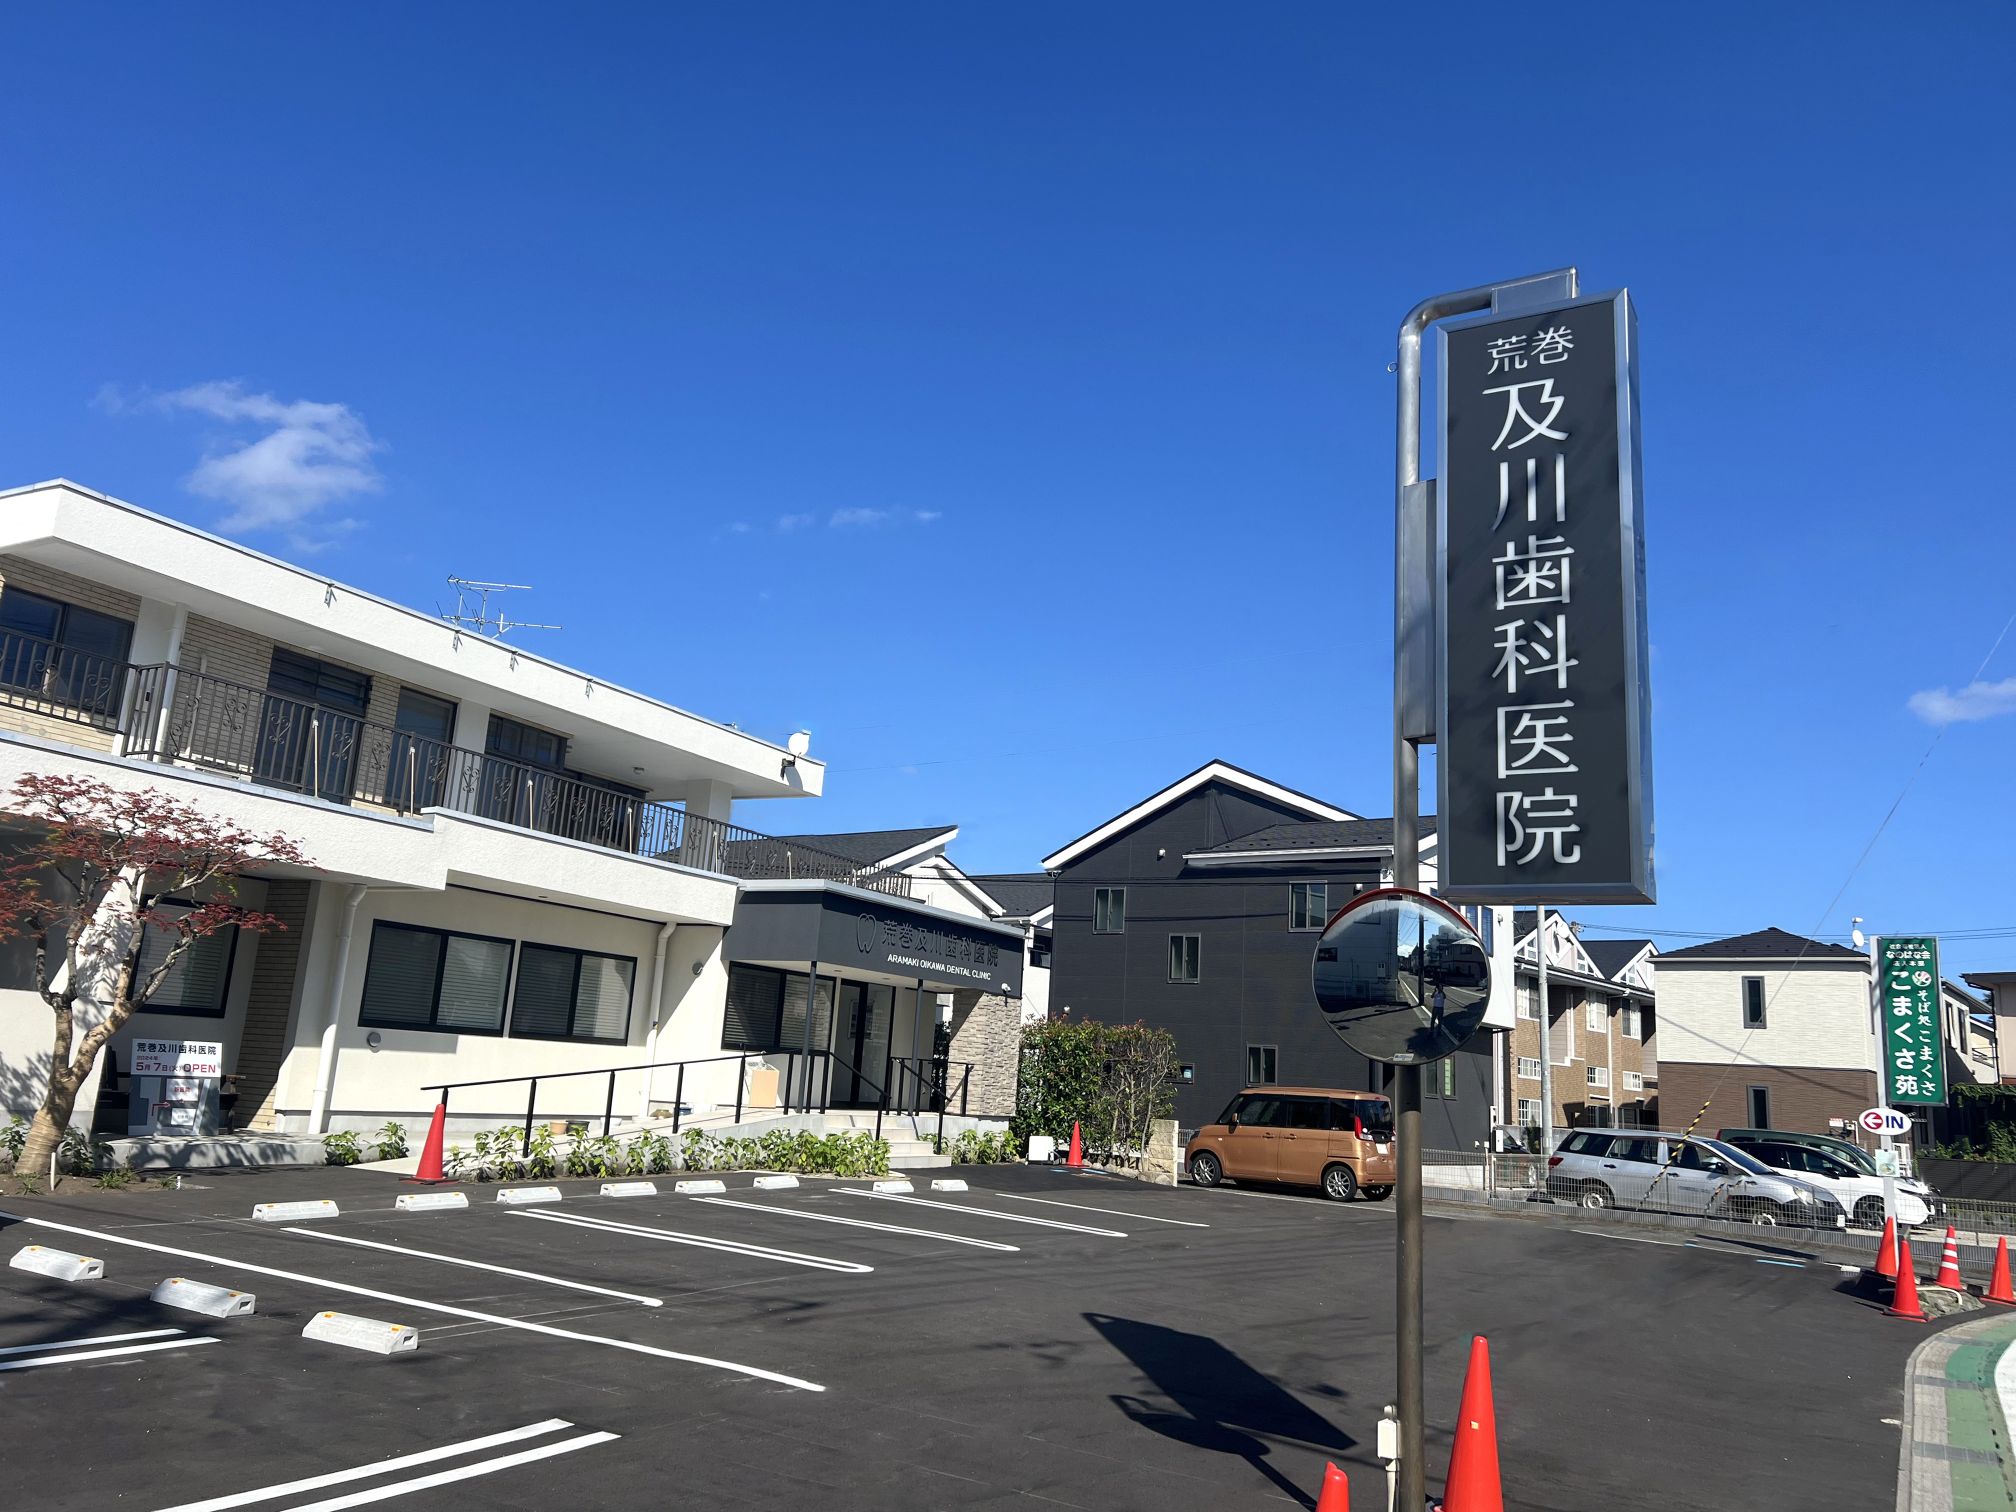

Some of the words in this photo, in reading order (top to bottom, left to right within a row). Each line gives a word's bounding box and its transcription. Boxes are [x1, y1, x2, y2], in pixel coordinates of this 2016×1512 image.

[1486, 326, 1574, 375] 荒巻
[1481, 376, 1581, 868] 及川歯科医院
[881, 919, 1000, 967] 荒巻及川歯科医院
[887, 953, 919, 967] ARAMAKI
[919, 959, 946, 972] OIKAWA
[946, 964, 971, 976] DENTAL
[971, 969, 992, 980] CLINIC
[136, 1042, 217, 1056] 荒巻及川歯科医院
[1891, 970, 1919, 1096] こまくさ苑
[1917, 989, 1936, 1097] そば処こまくさ
[183, 1063, 216, 1073] OPEN
[1885, 1115, 1904, 1129] IN
